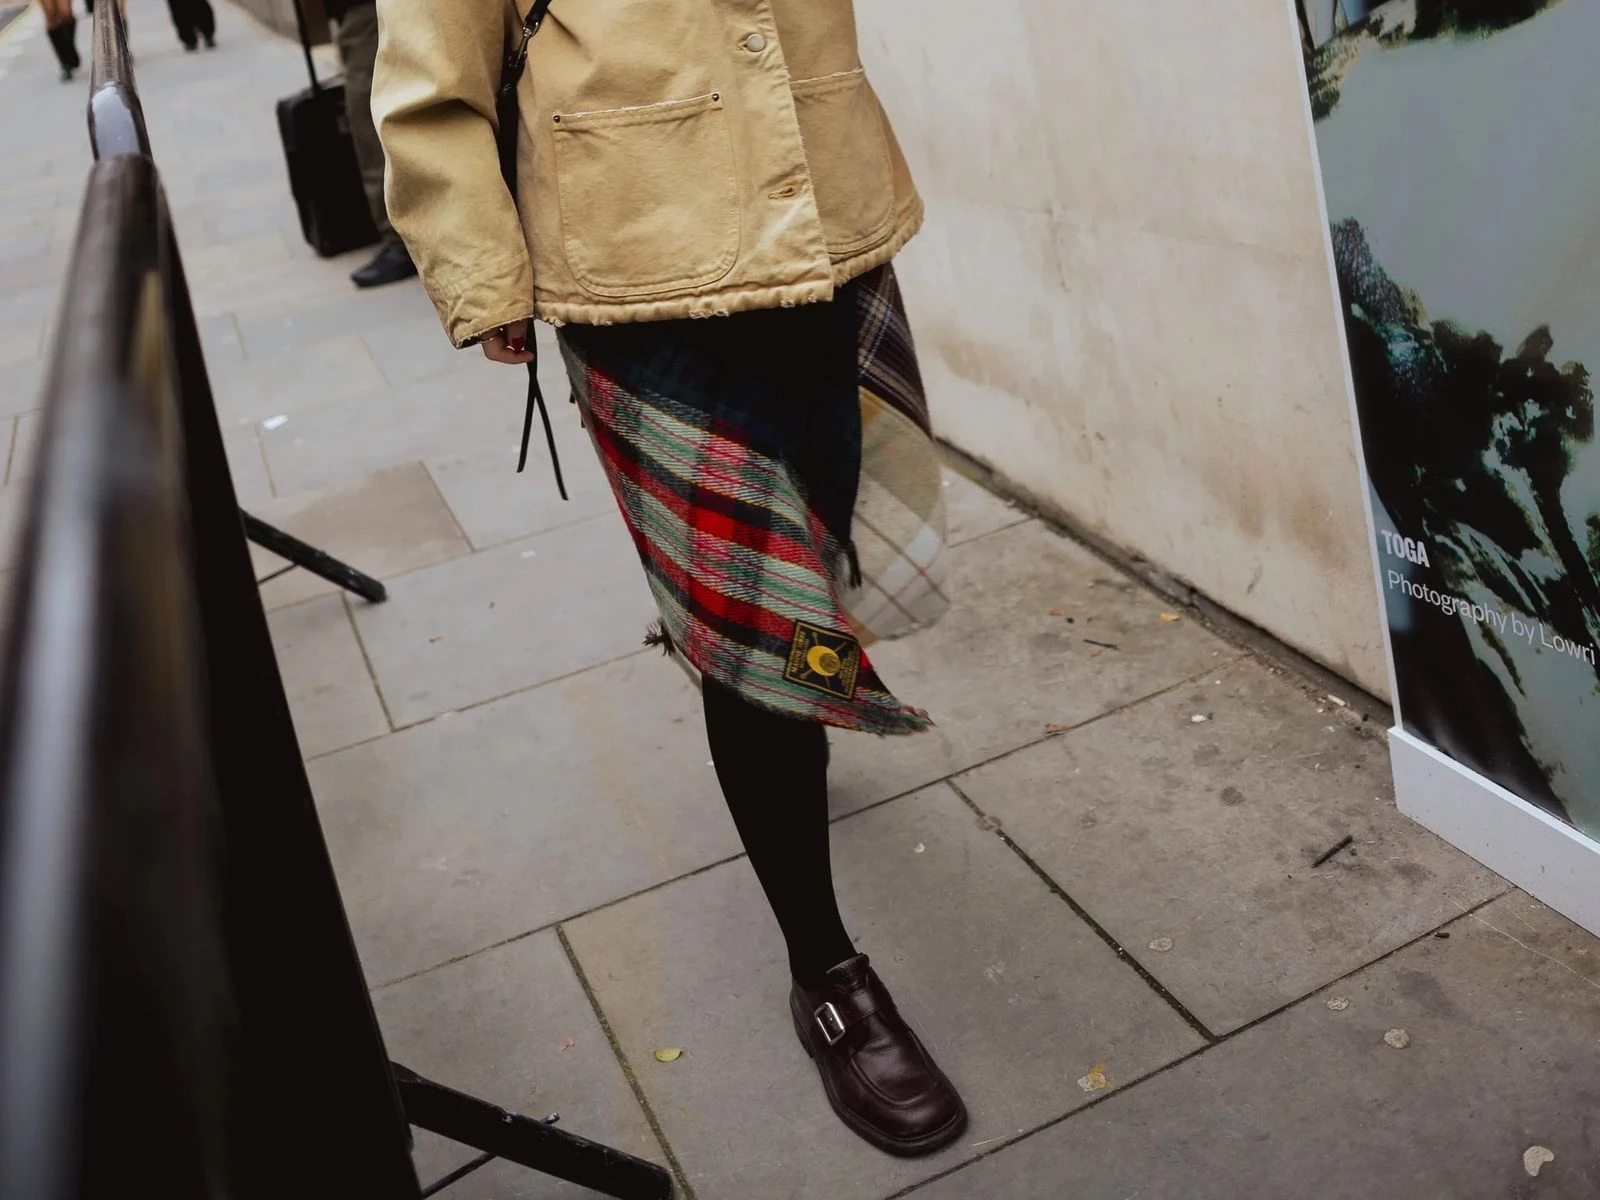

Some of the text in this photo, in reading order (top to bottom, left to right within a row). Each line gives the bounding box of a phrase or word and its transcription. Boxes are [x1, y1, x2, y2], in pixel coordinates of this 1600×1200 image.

[1381, 529, 1430, 568] TOGA
[1387, 570, 1596, 666] Photography by Lowri
